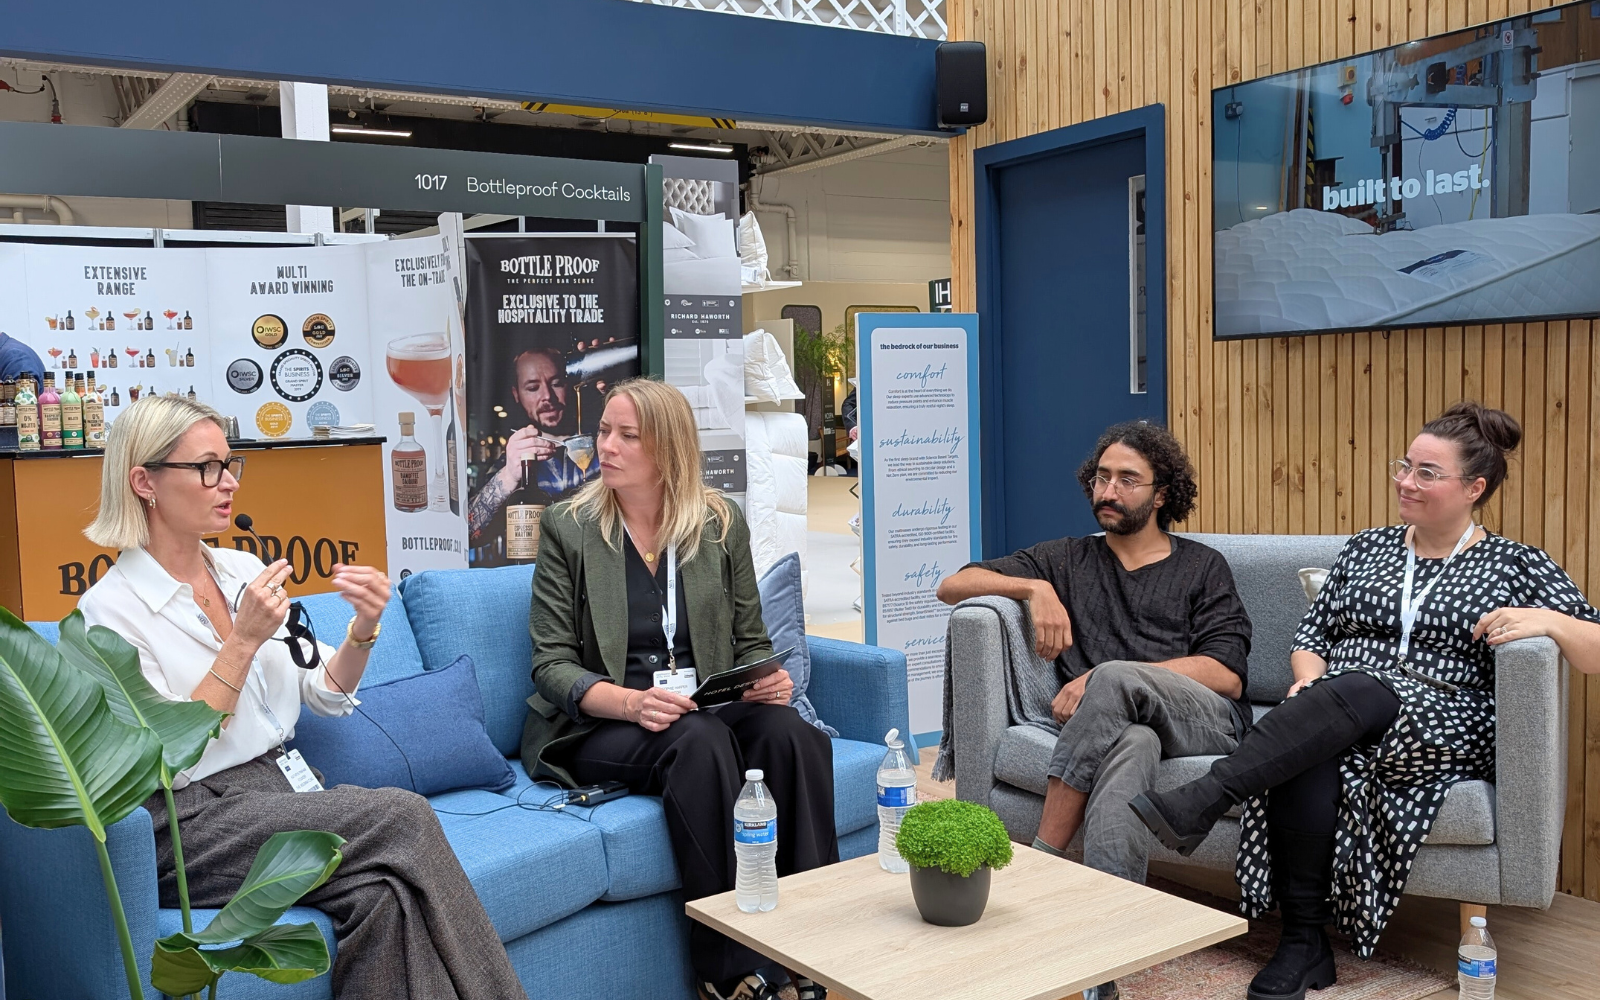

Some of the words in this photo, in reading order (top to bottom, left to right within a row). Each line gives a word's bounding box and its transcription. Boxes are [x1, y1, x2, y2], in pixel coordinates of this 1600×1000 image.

[414, 174, 448, 191] 1017
[467, 177, 558, 199] Bottleproof
[562, 182, 630, 202] Cocktails
[1322, 178, 1386, 210] built
[1390, 176, 1420, 200] to
[1426, 164, 1490, 196] last.
[276, 265, 307, 278] MULTI
[395, 254, 439, 272] EXCLUSIVELY
[500, 255, 552, 276] BOTTLE
[555, 255, 600, 276] PROOF
[84, 266, 147, 280] EXTENSIVE
[401, 274, 416, 287] THE
[97, 282, 136, 295] RANGE
[250, 281, 288, 294] AWARD
[291, 280, 333, 294] WINNING
[502, 294, 560, 308] EXCLUSIVE
[563, 294, 576, 308] TO
[579, 294, 598, 308] THE
[498, 309, 566, 323] HOSPITALITY
[570, 309, 604, 323] TRADE
[896, 362, 947, 388] comfort
[879, 427, 965, 454] sustainability
[892, 498, 955, 525] durability
[904, 561, 946, 588] safety
